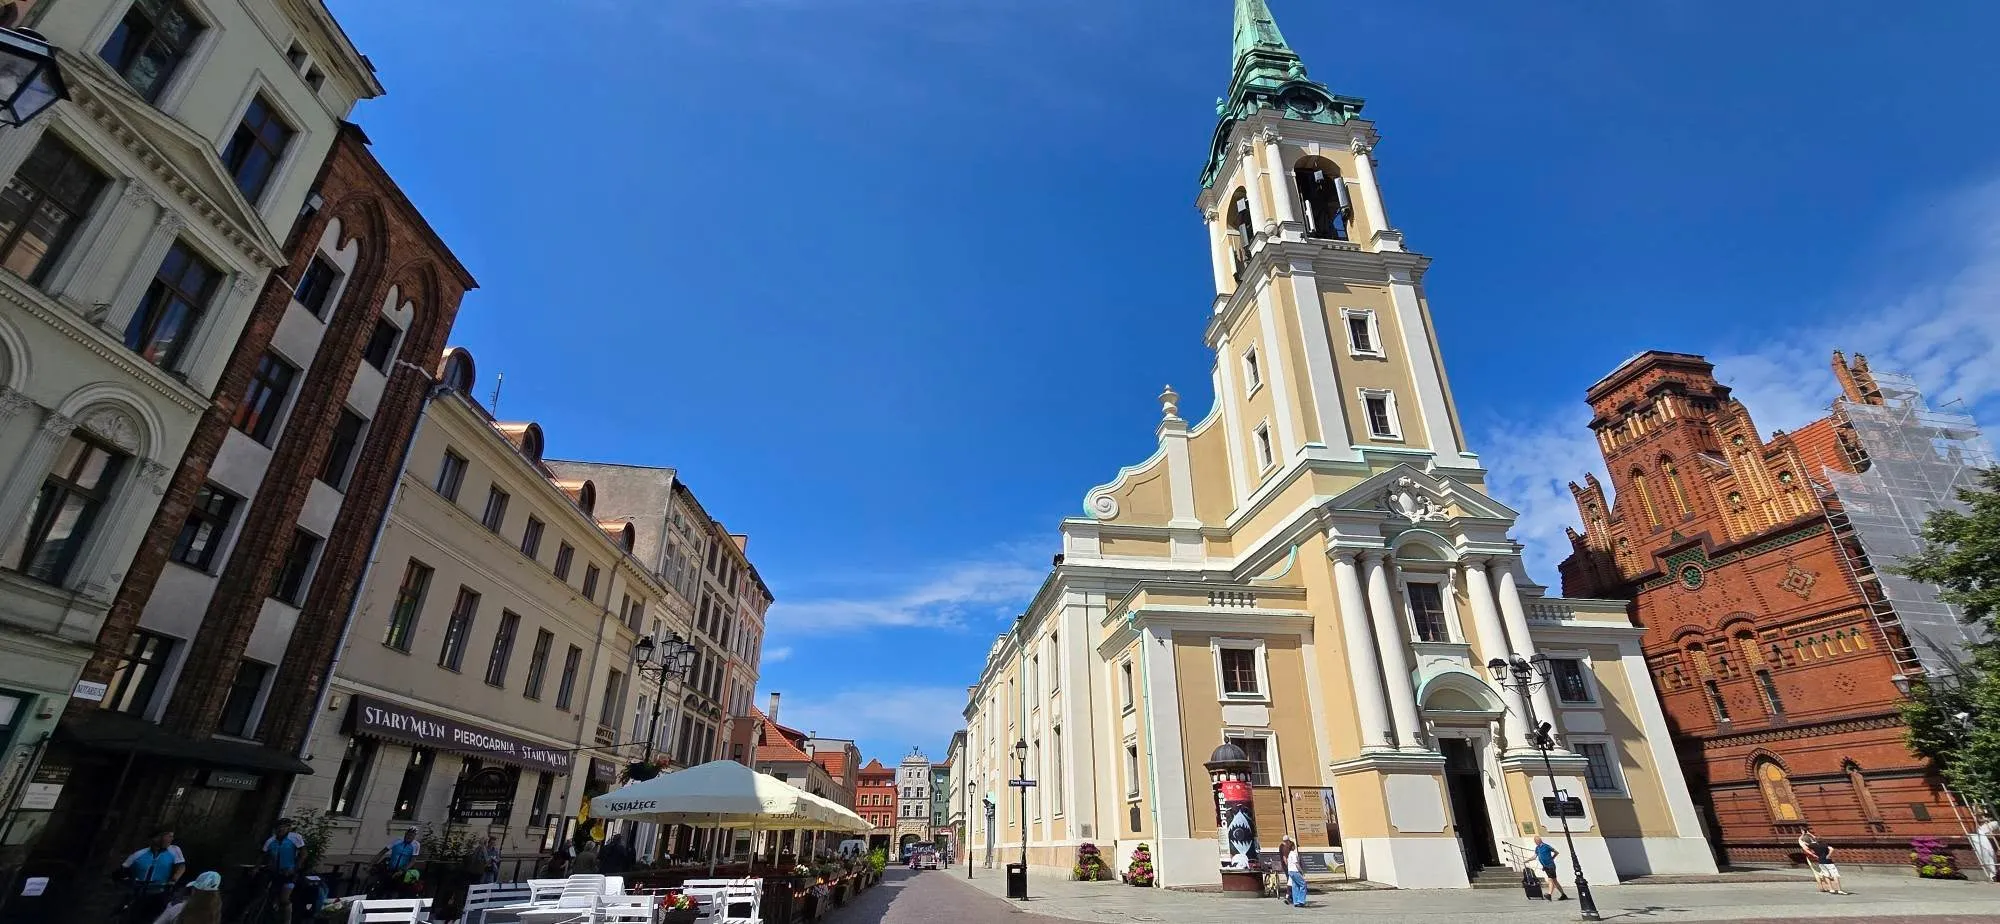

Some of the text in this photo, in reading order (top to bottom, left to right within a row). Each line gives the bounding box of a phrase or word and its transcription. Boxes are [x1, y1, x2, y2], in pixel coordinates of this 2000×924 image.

[364, 706, 445, 739] STARY MŁYN
[454, 728, 515, 755] PIEROGARNIA
[521, 745, 546, 762] STARY
[610, 799, 657, 812] KSIĄŻĘCE
